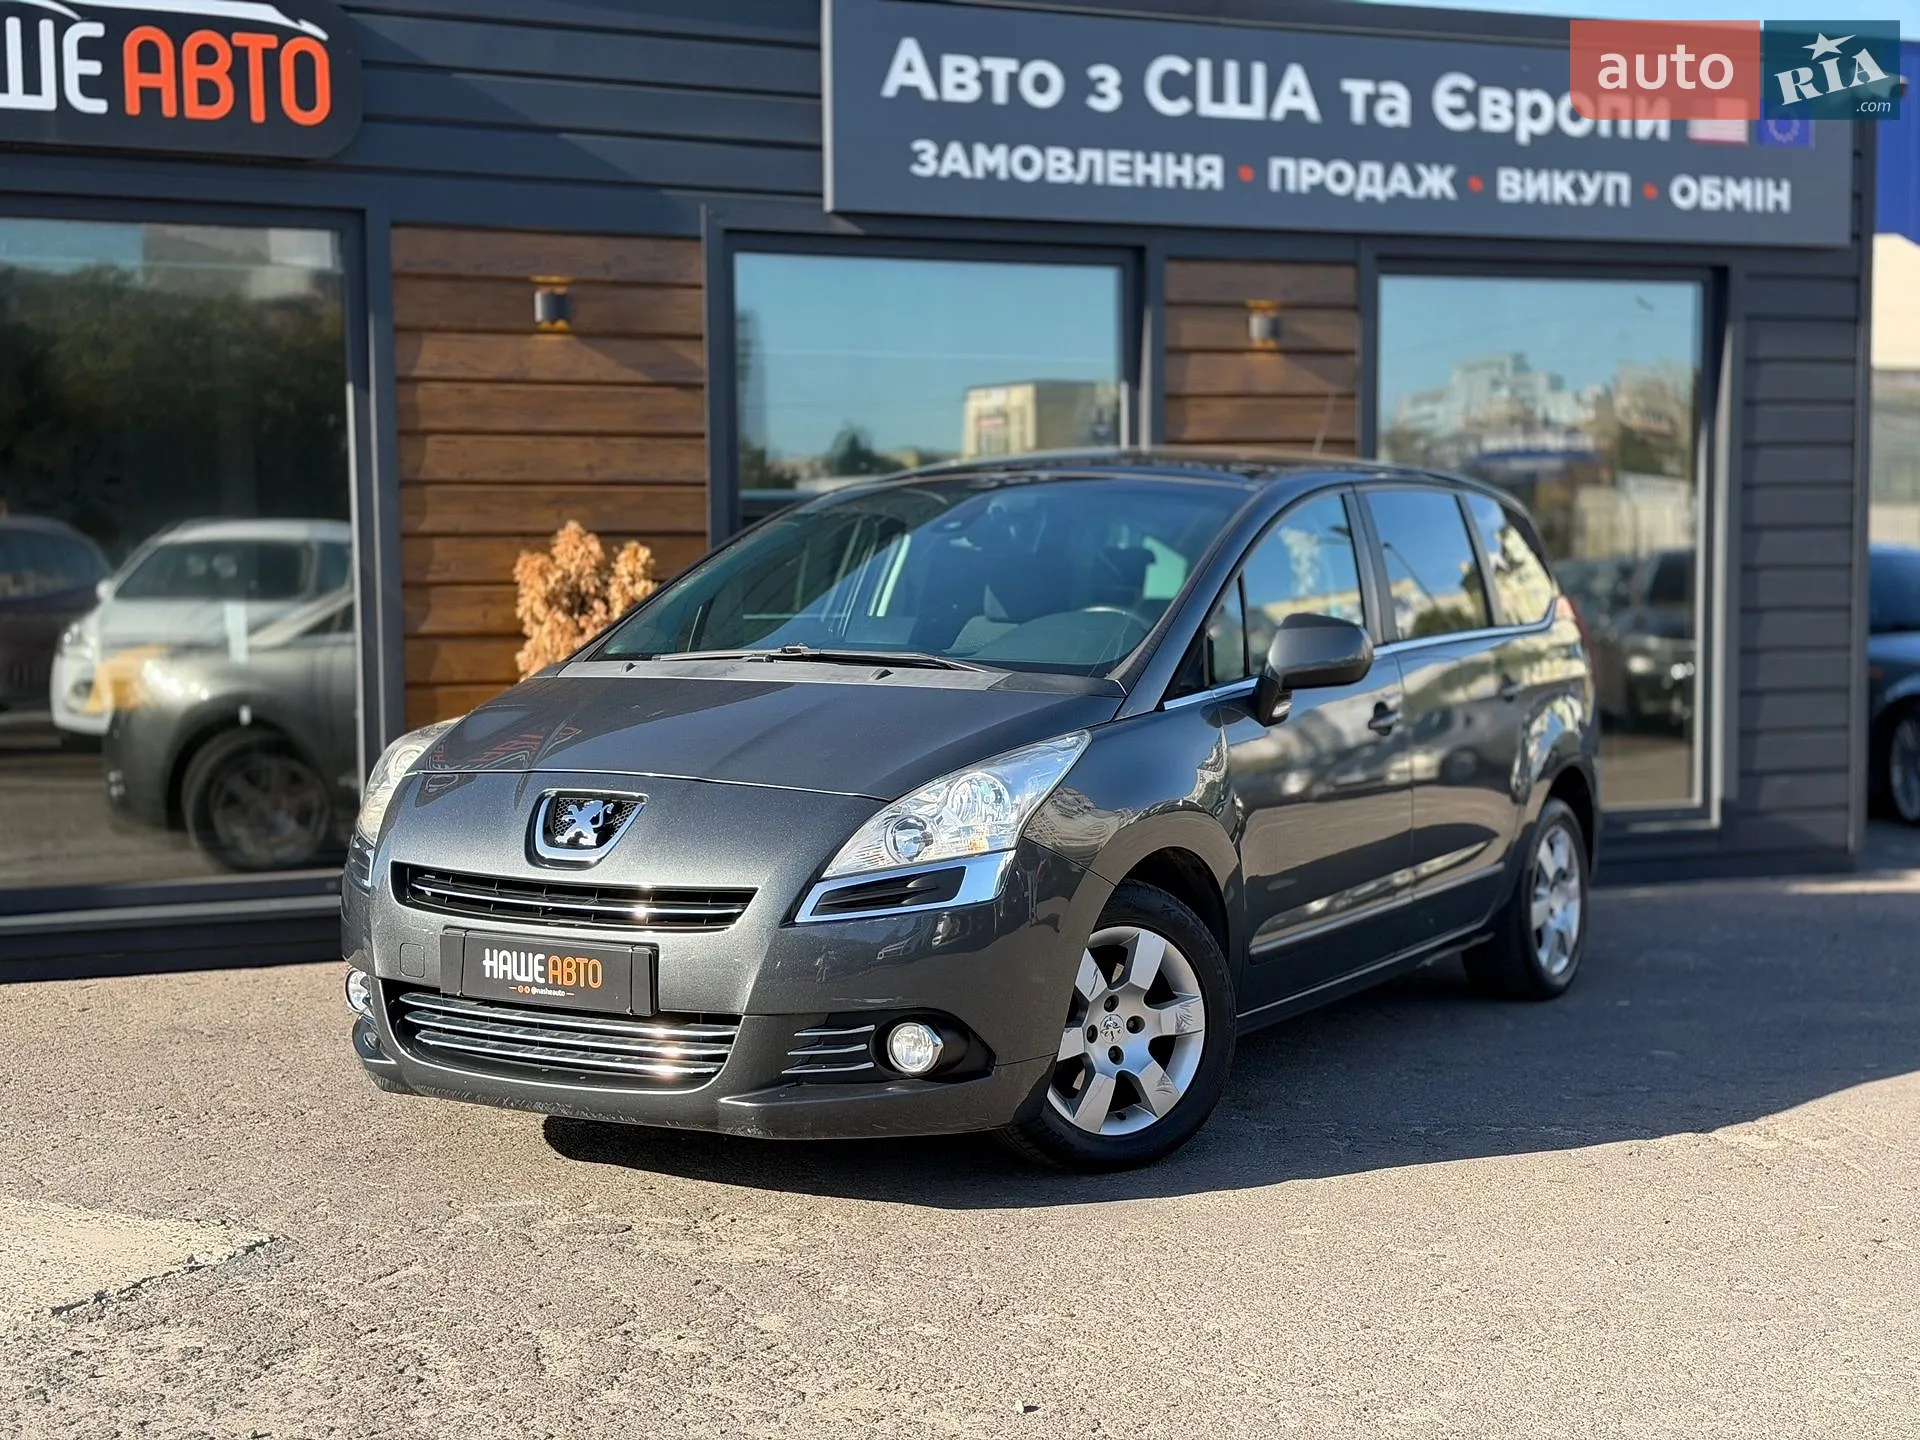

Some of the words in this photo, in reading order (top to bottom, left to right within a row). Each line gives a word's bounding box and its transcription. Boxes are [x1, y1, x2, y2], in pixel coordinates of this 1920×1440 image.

[122, 25, 331, 126] АВТО
[880, 37, 1065, 109] Авто
[1085, 64, 1123, 113] з
[1143, 54, 1322, 123] США
[1340, 78, 1411, 128] та
[1431, 71, 1671, 146] Європи
[910, 139, 1224, 190] ЗАМОВЛЕННЯ
[1267, 156, 1457, 202] ПРОДАЖ
[1496, 166, 1632, 207] ВИКУП
[1668, 174, 1793, 214] ОБМІН
[482, 948, 545, 984] НАШЕ
[548, 954, 602, 989] АВТО
